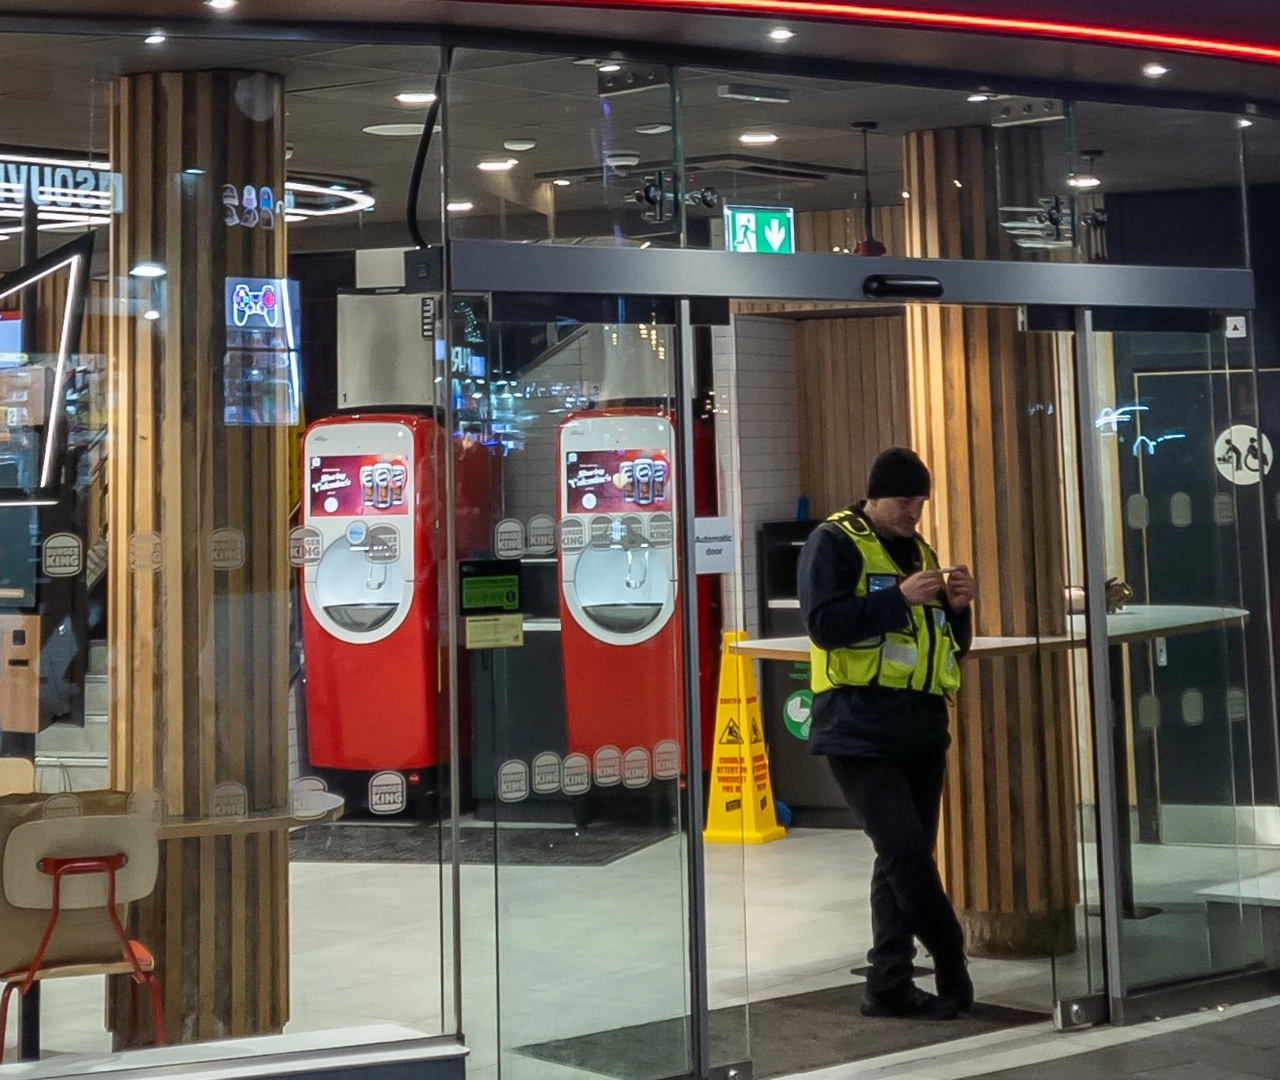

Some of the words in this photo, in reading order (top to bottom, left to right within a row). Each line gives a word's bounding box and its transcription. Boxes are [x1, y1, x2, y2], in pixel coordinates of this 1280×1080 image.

[498, 540, 522, 550] KING
[531, 535, 554, 546] KING
[45, 554, 79, 568] KING
[598, 767, 620, 777] KING
[625, 768, 648, 779] KING
[536, 773, 559, 785] KING
[564, 774, 588, 785] KING
[503, 782, 526, 792] KING
[373, 793, 402, 806] KING
